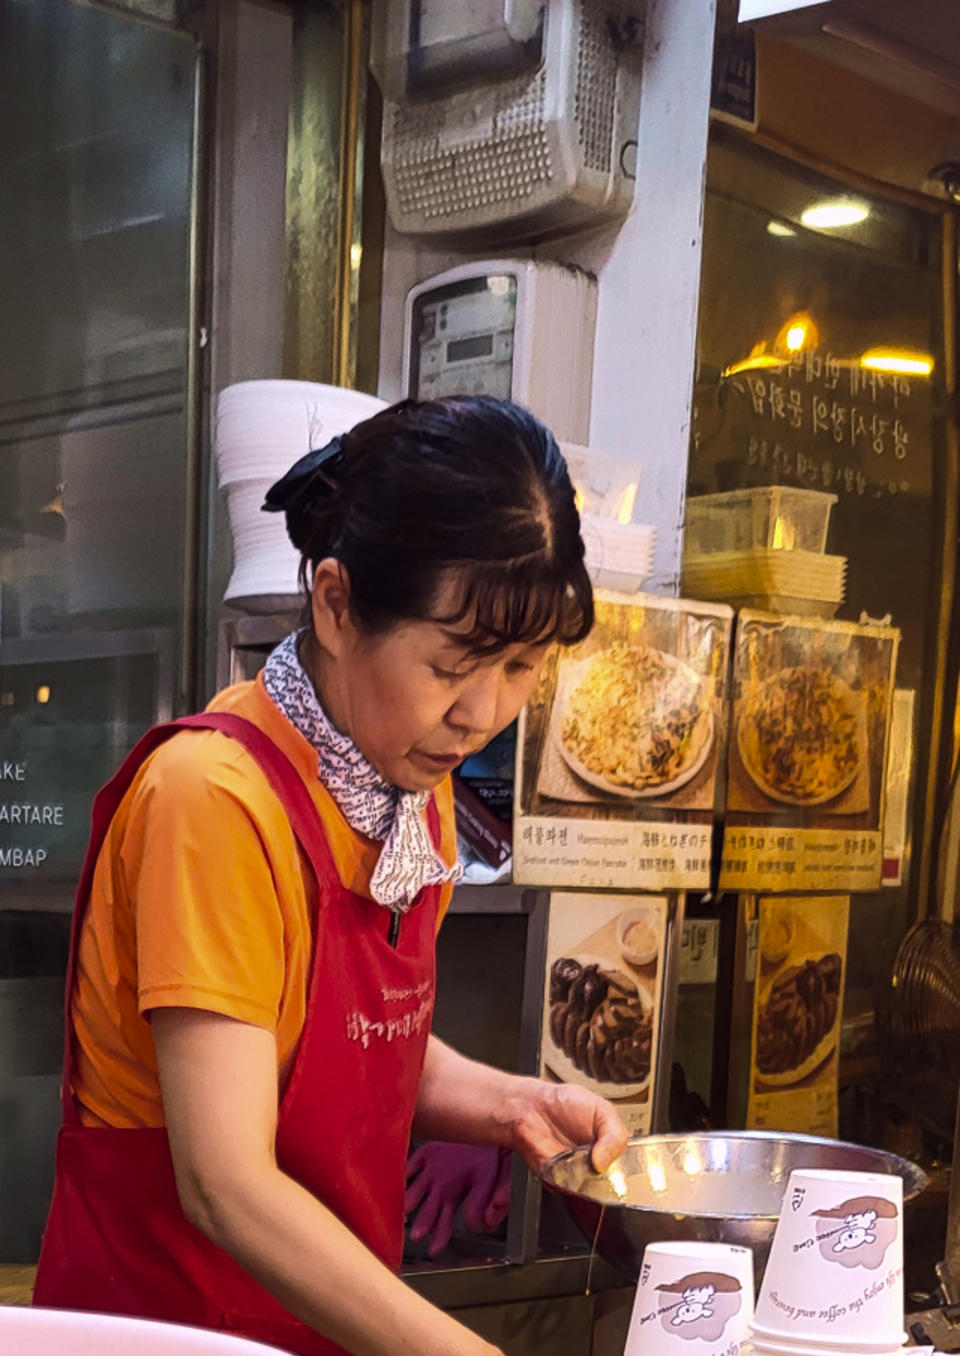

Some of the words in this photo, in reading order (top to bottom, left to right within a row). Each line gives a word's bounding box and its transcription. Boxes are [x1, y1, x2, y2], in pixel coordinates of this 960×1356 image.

[847, 1298, 864, 1313] the
[795, 1308, 816, 1320] and
[818, 1305, 847, 1323] coffee
